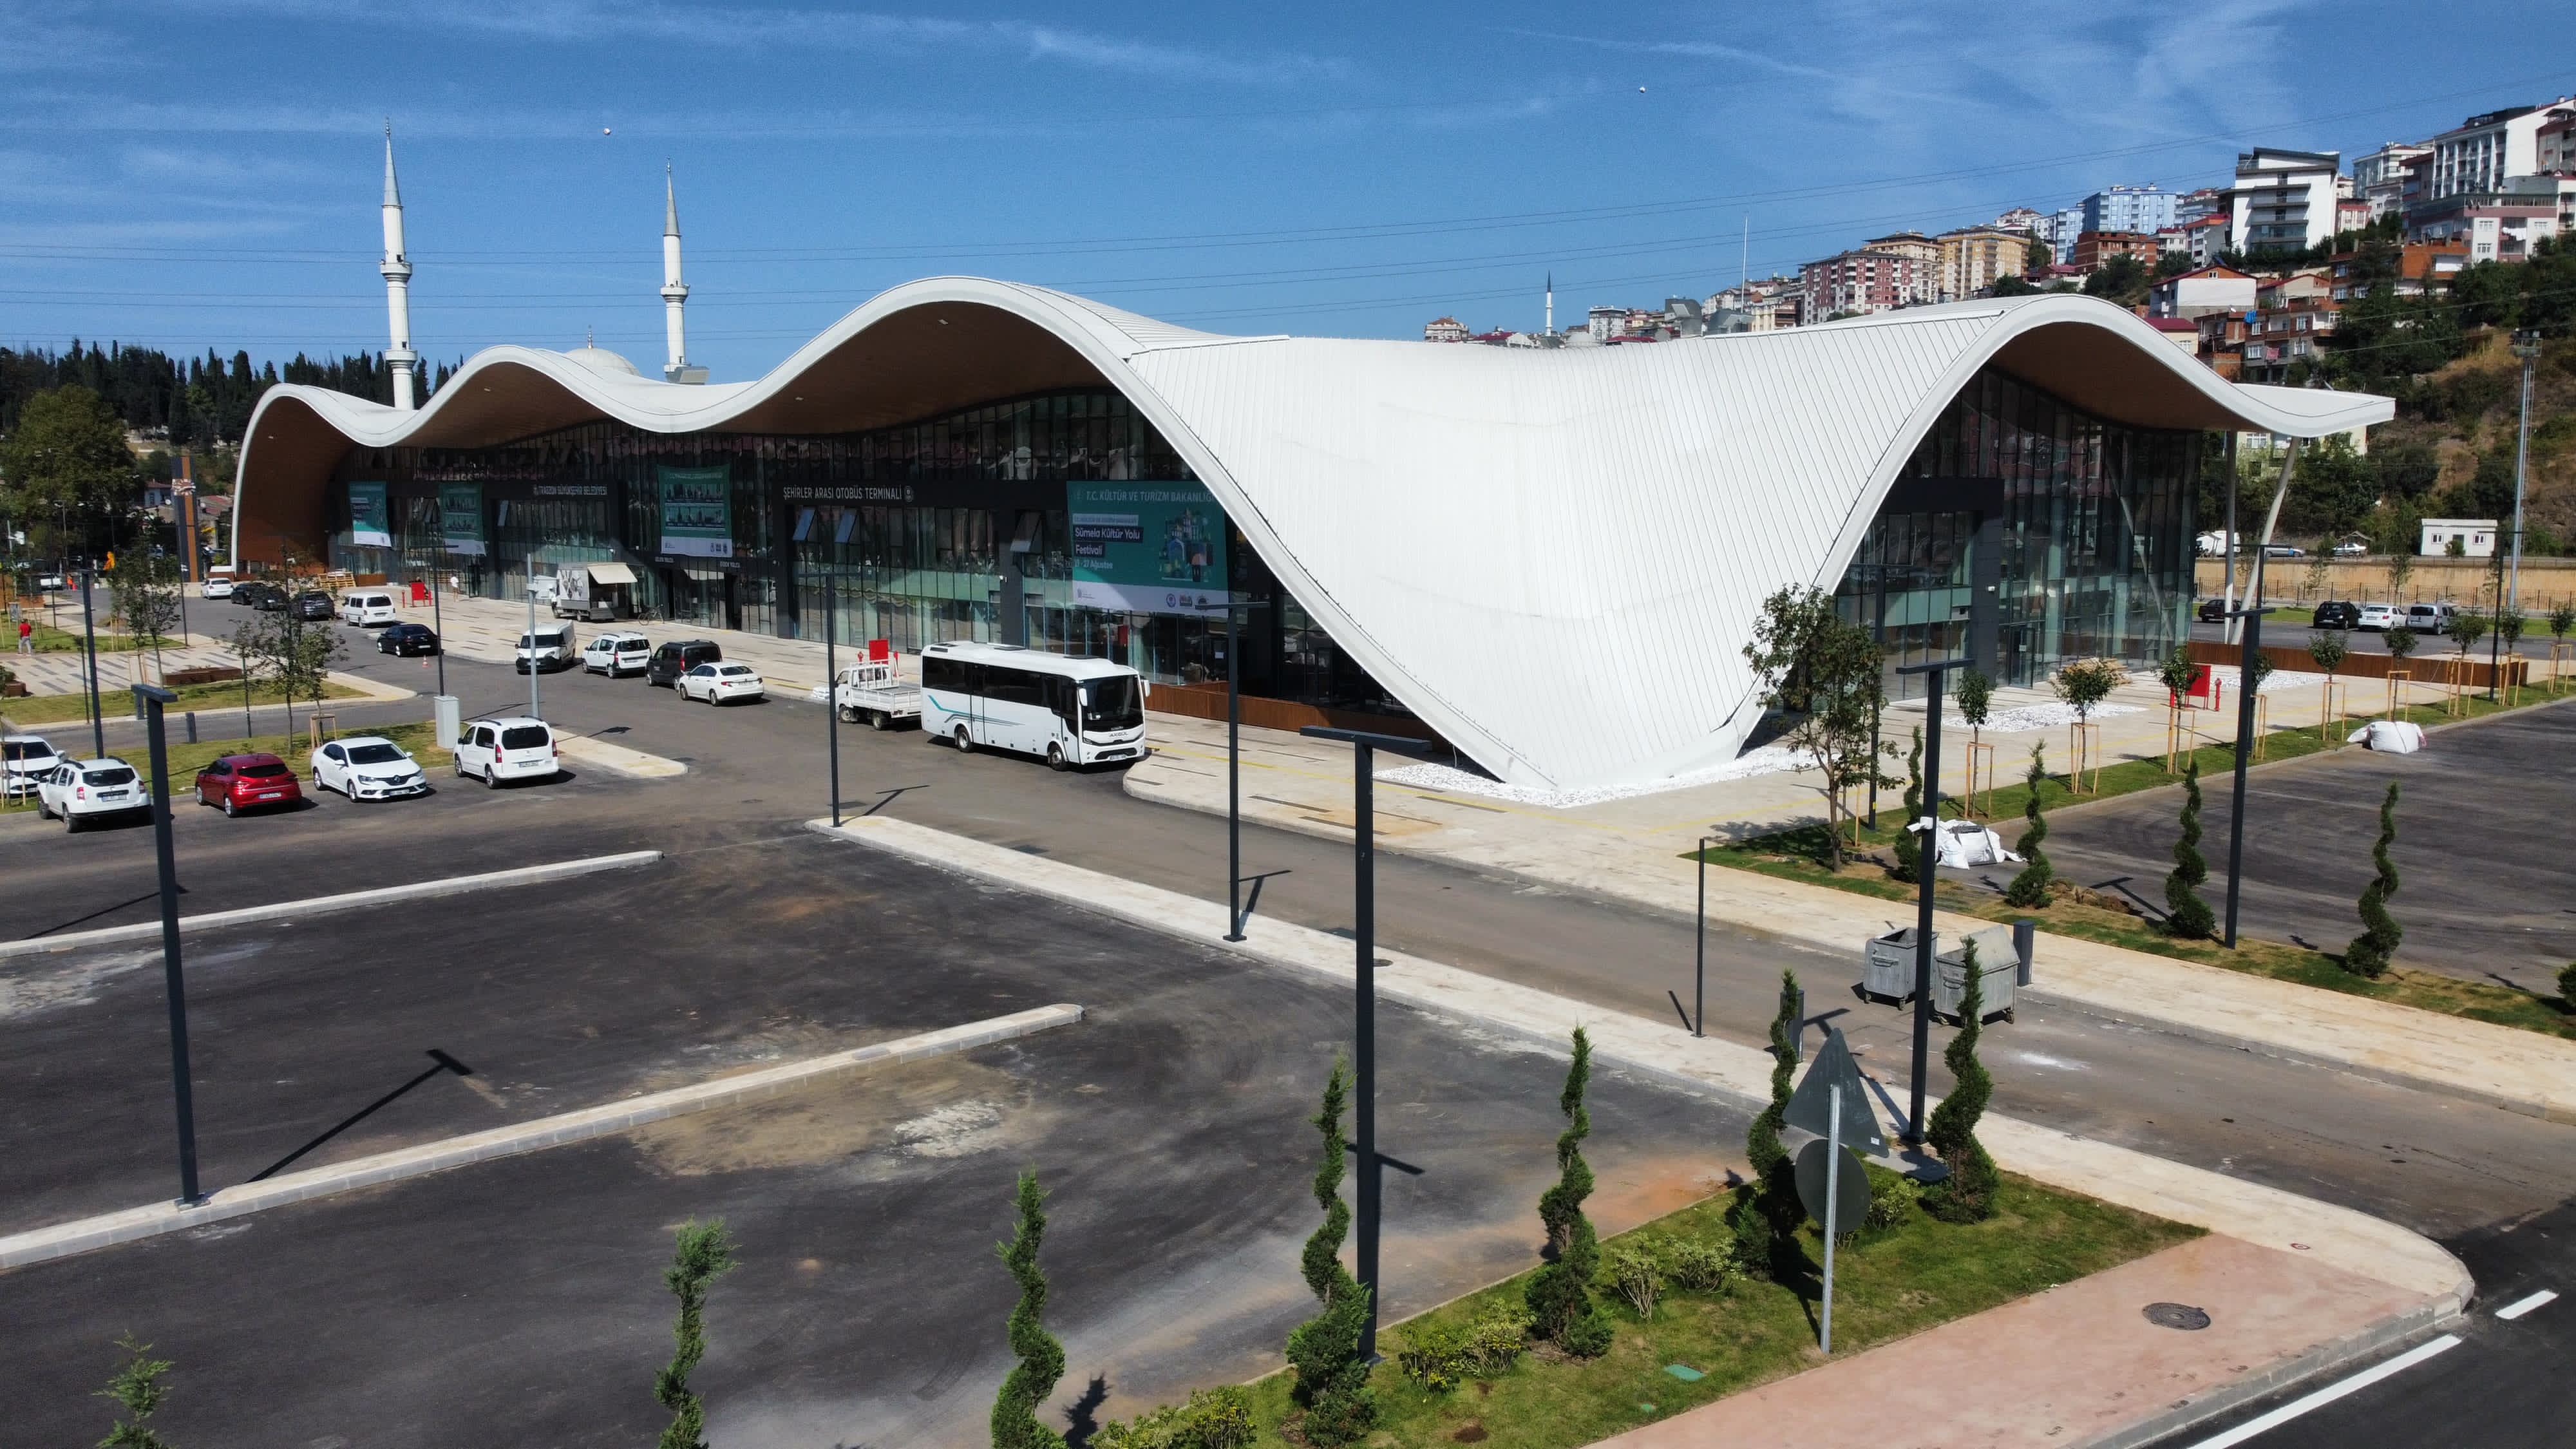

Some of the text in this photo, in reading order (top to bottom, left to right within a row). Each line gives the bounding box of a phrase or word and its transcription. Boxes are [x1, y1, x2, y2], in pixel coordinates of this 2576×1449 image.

[783, 484, 902, 500] ŞEHİRLER ARASI OTOBÜS TERMİNALİ
[1100, 489, 1127, 501] KÜLTÜR
[1129, 491, 1138, 500] VE
[1140, 489, 1169, 501] TURİZM
[1075, 527, 1140, 540] Sümela Kültür Yolu
[1075, 544, 1103, 555] Festivali
